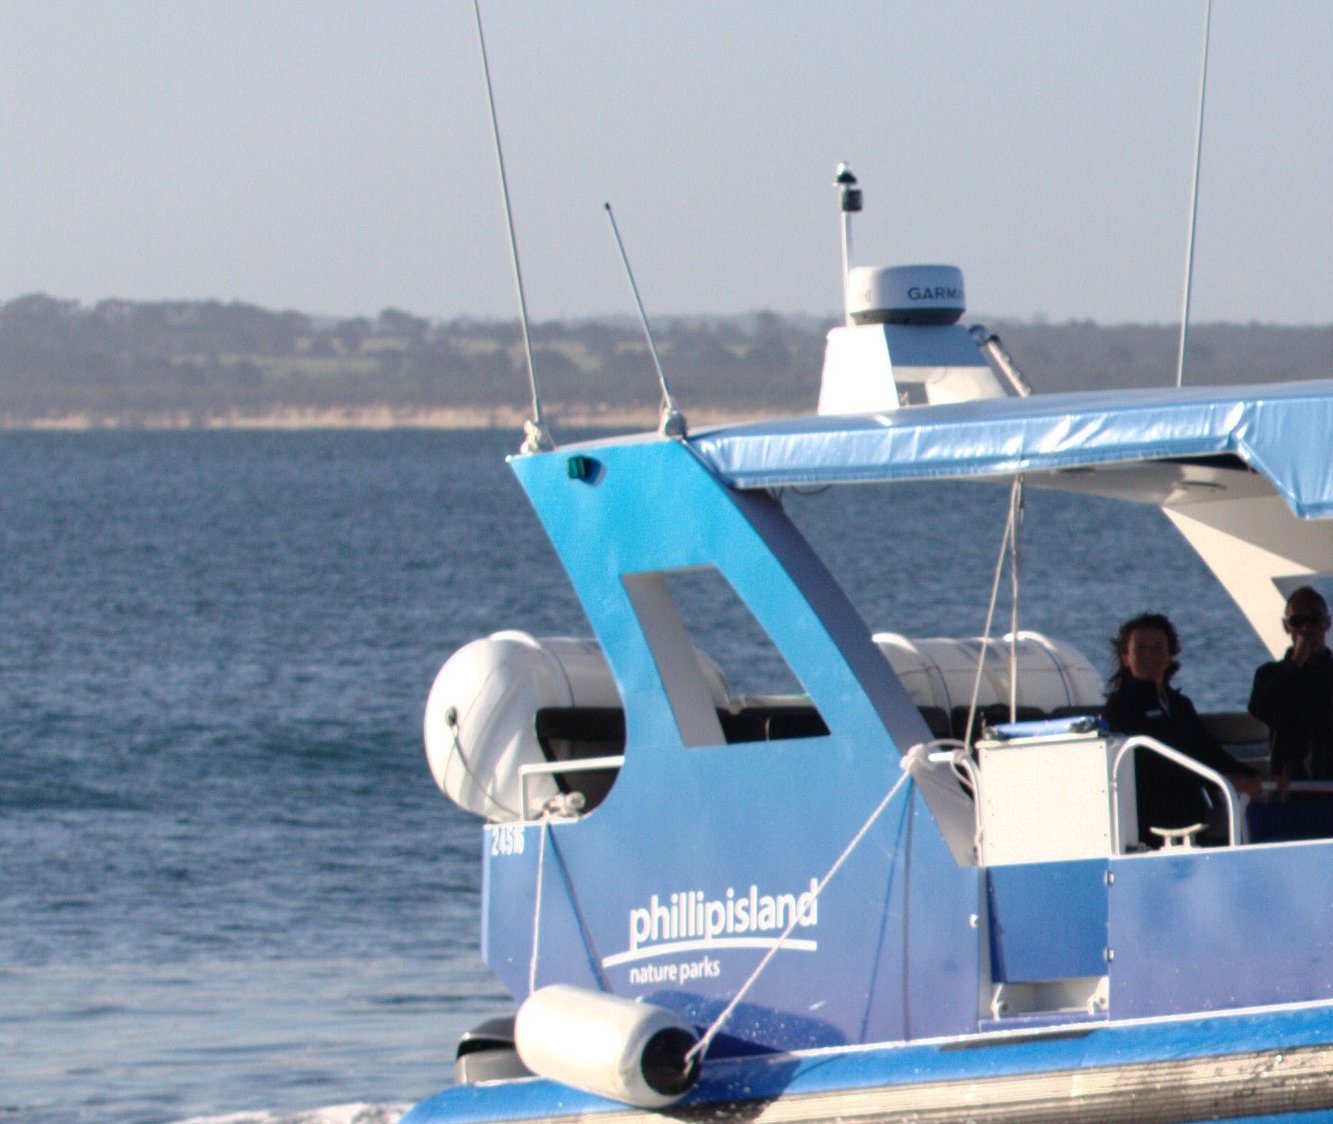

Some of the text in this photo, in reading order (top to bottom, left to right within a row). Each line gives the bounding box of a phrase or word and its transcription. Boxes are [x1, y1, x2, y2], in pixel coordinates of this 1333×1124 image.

[629, 877, 818, 951] phillipisland
[629, 956, 721, 985] nature parks
